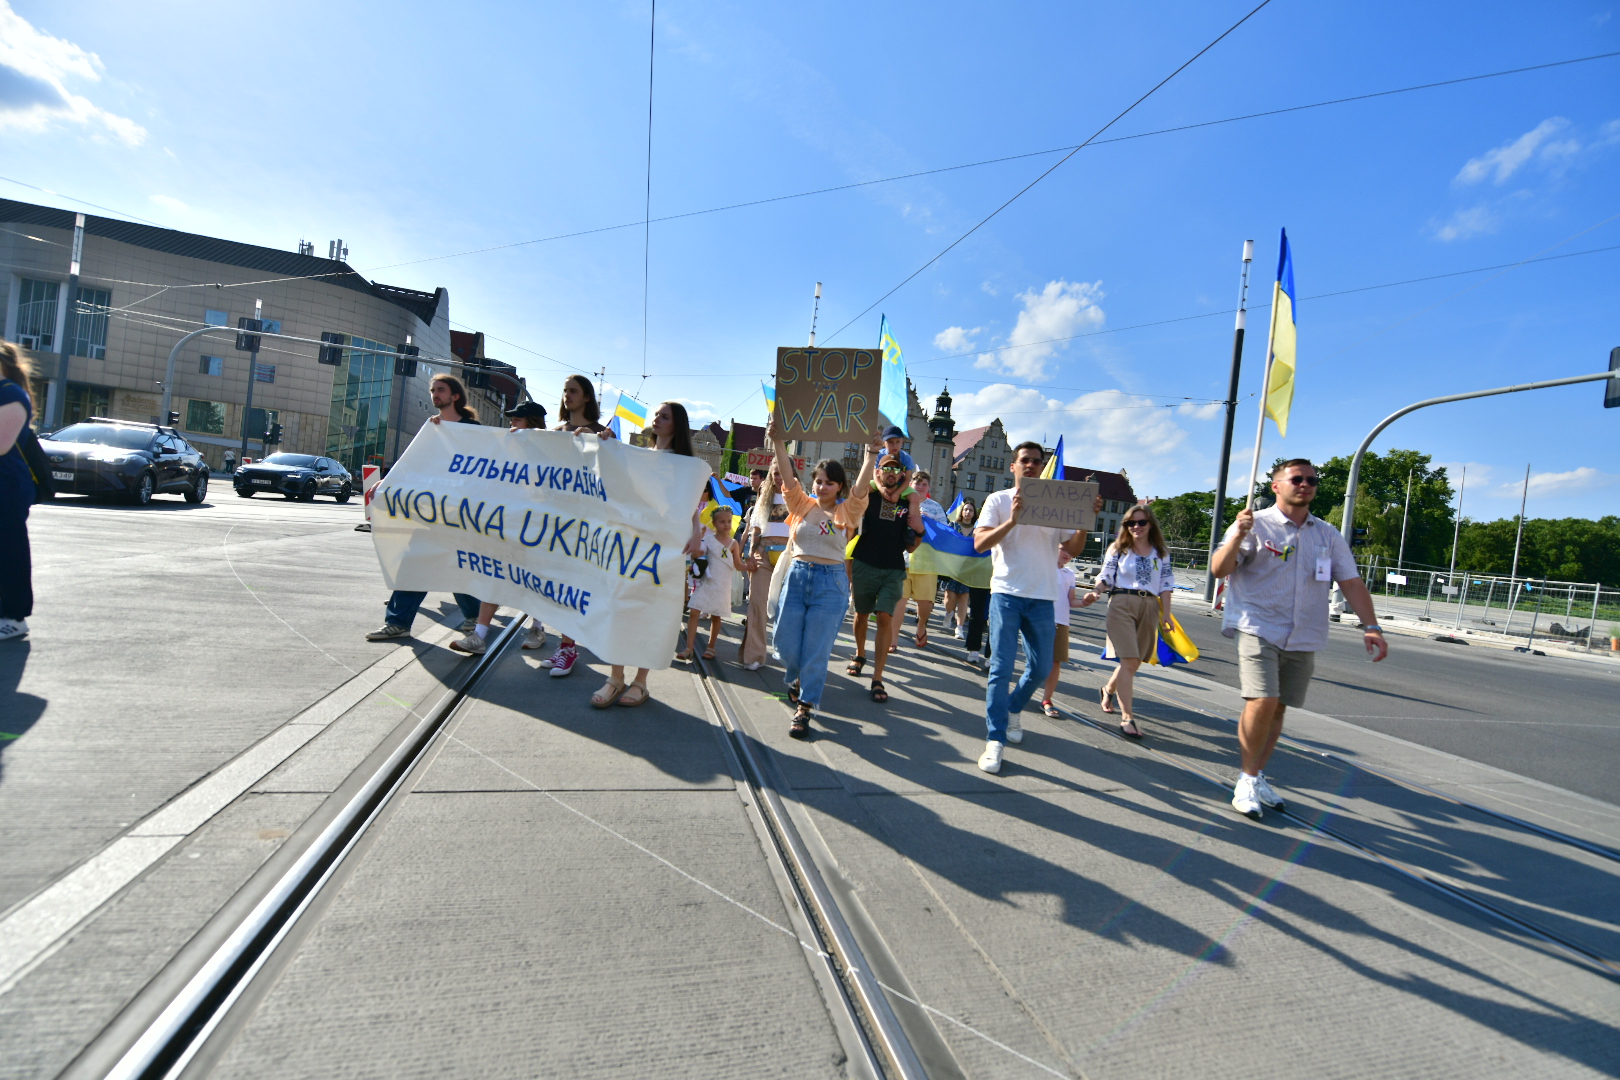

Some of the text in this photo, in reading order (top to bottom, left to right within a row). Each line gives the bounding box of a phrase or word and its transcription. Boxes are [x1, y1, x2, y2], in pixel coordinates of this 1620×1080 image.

[778, 350, 874, 385] STOP
[812, 382, 840, 393] THE
[778, 392, 870, 436] WAR
[448, 453, 608, 502] ВІЛЬНА УКРАЇНА
[1023, 483, 1093, 501] СЛАВА
[384, 486, 662, 587] WOLNA UKRAINA
[456, 549, 592, 617] FREE UKRAINE
